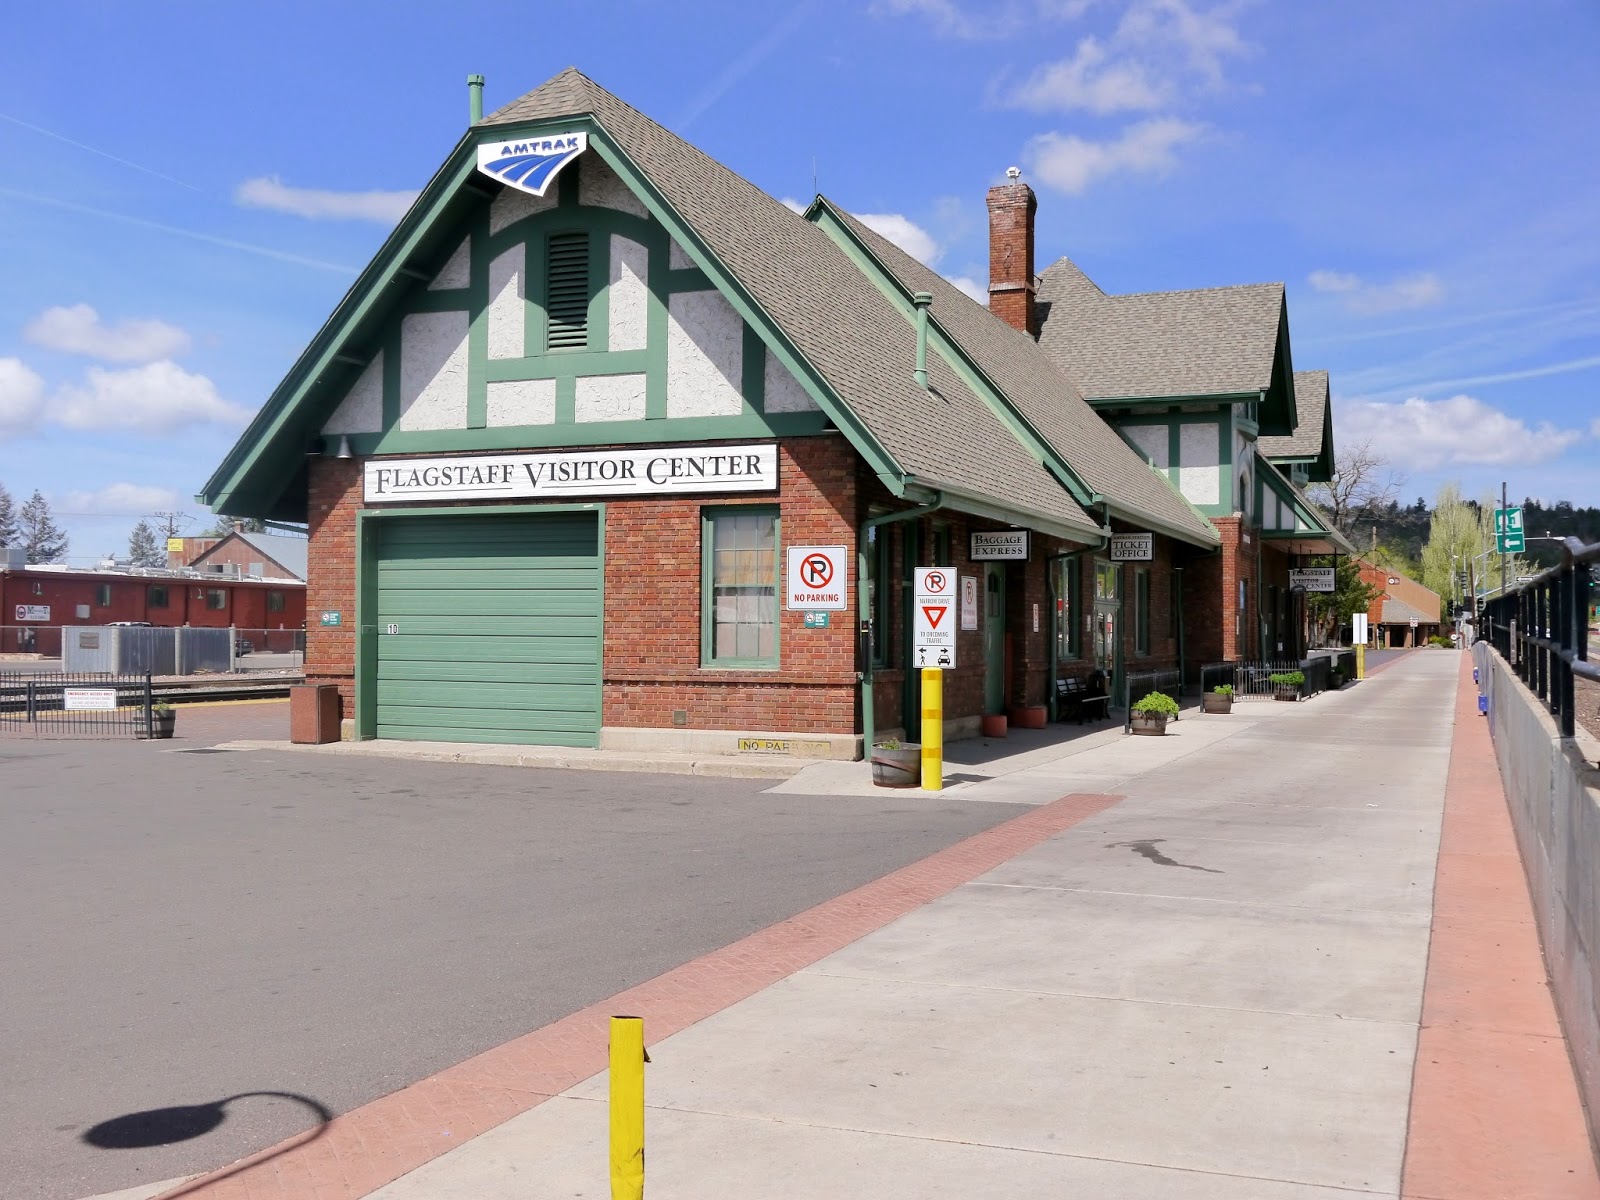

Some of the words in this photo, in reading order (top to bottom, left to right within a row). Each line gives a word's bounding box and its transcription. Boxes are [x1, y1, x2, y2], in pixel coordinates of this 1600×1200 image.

[501, 137, 578, 155] AMTRAK
[374, 464, 515, 494] FLAGSTAFF
[522, 459, 637, 489] VISITOR
[646, 454, 763, 486] CENTER
[974, 534, 1023, 545] BAGGAGE
[1113, 541, 1151, 549] TICKET
[974, 547, 1023, 555] EXPRESS
[1114, 549, 1149, 558] OFFICE
[794, 593, 805, 602] NO
[806, 593, 839, 602] PARKING
[389, 624, 398, 634] 10
[743, 741, 759, 751] NO
